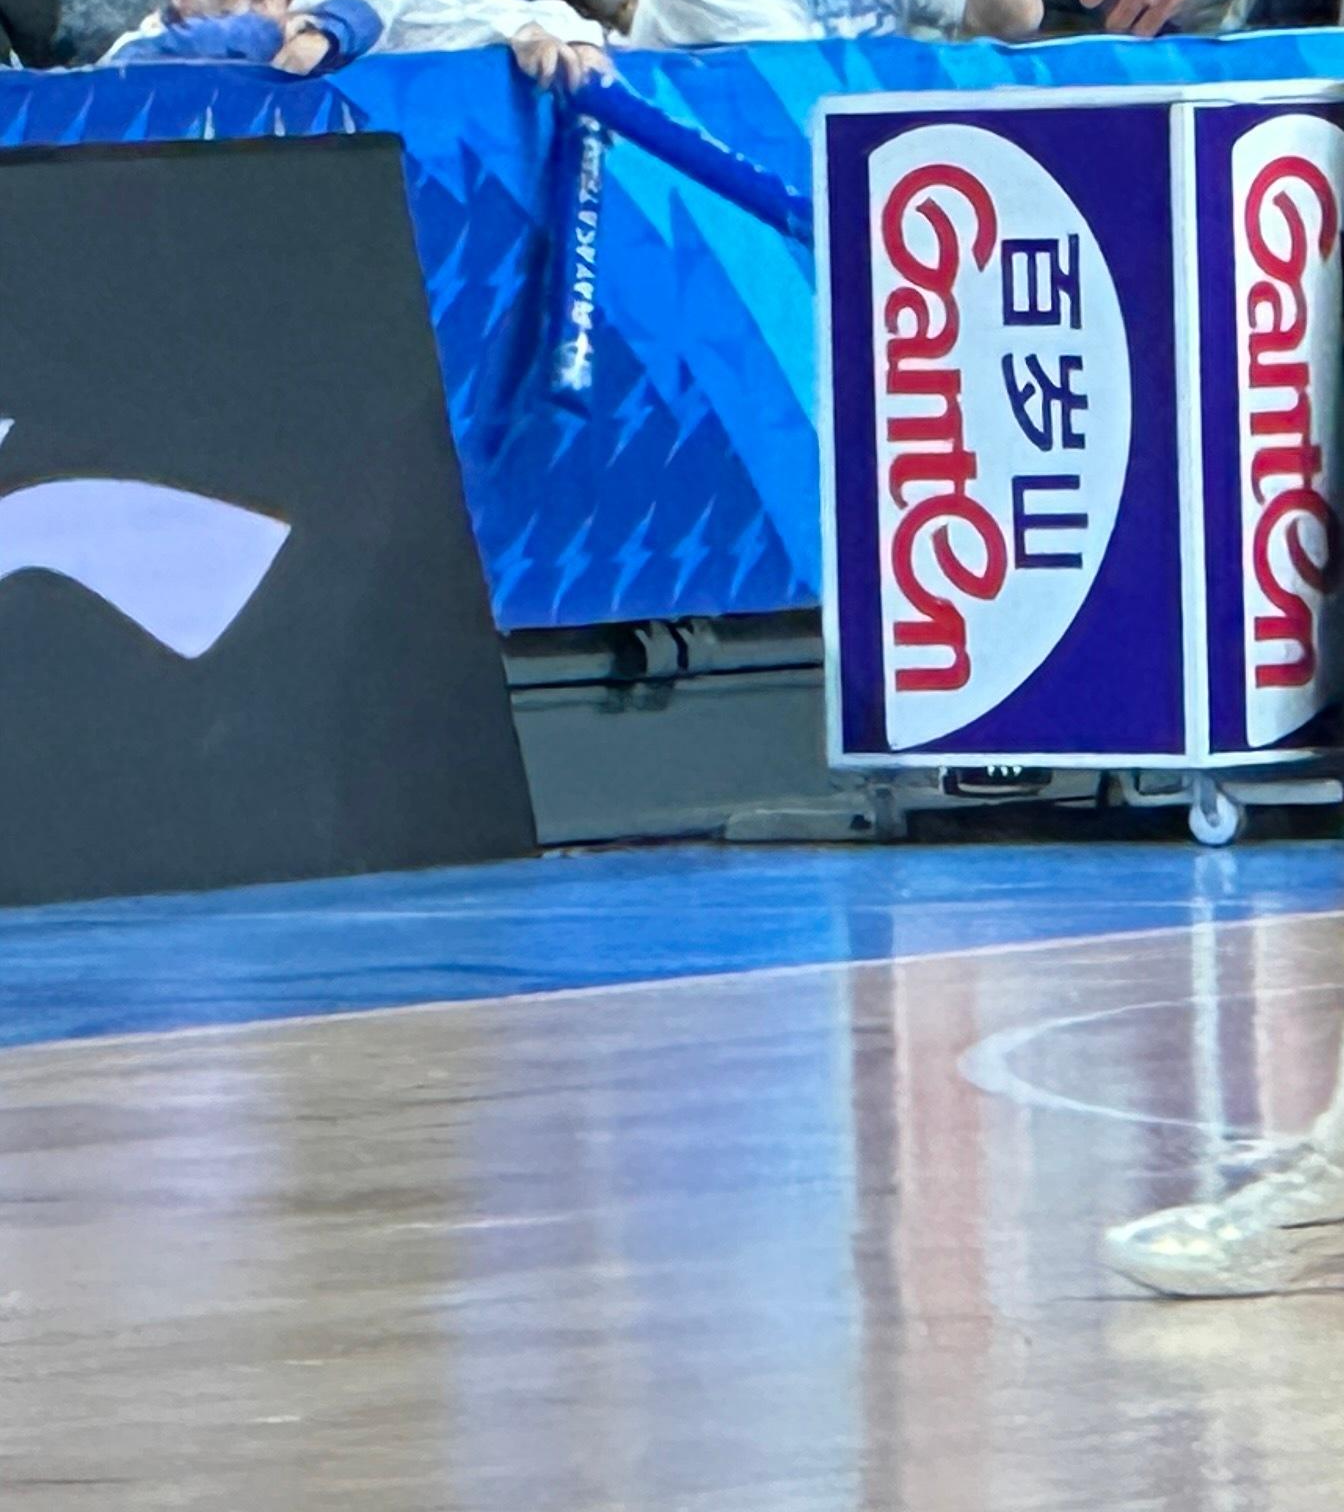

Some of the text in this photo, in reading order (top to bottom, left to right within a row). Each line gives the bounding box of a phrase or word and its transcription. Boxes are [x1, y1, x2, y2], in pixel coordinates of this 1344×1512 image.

[881, 163, 1010, 692] Ganten
[1001, 233, 1090, 571] 百岁山
